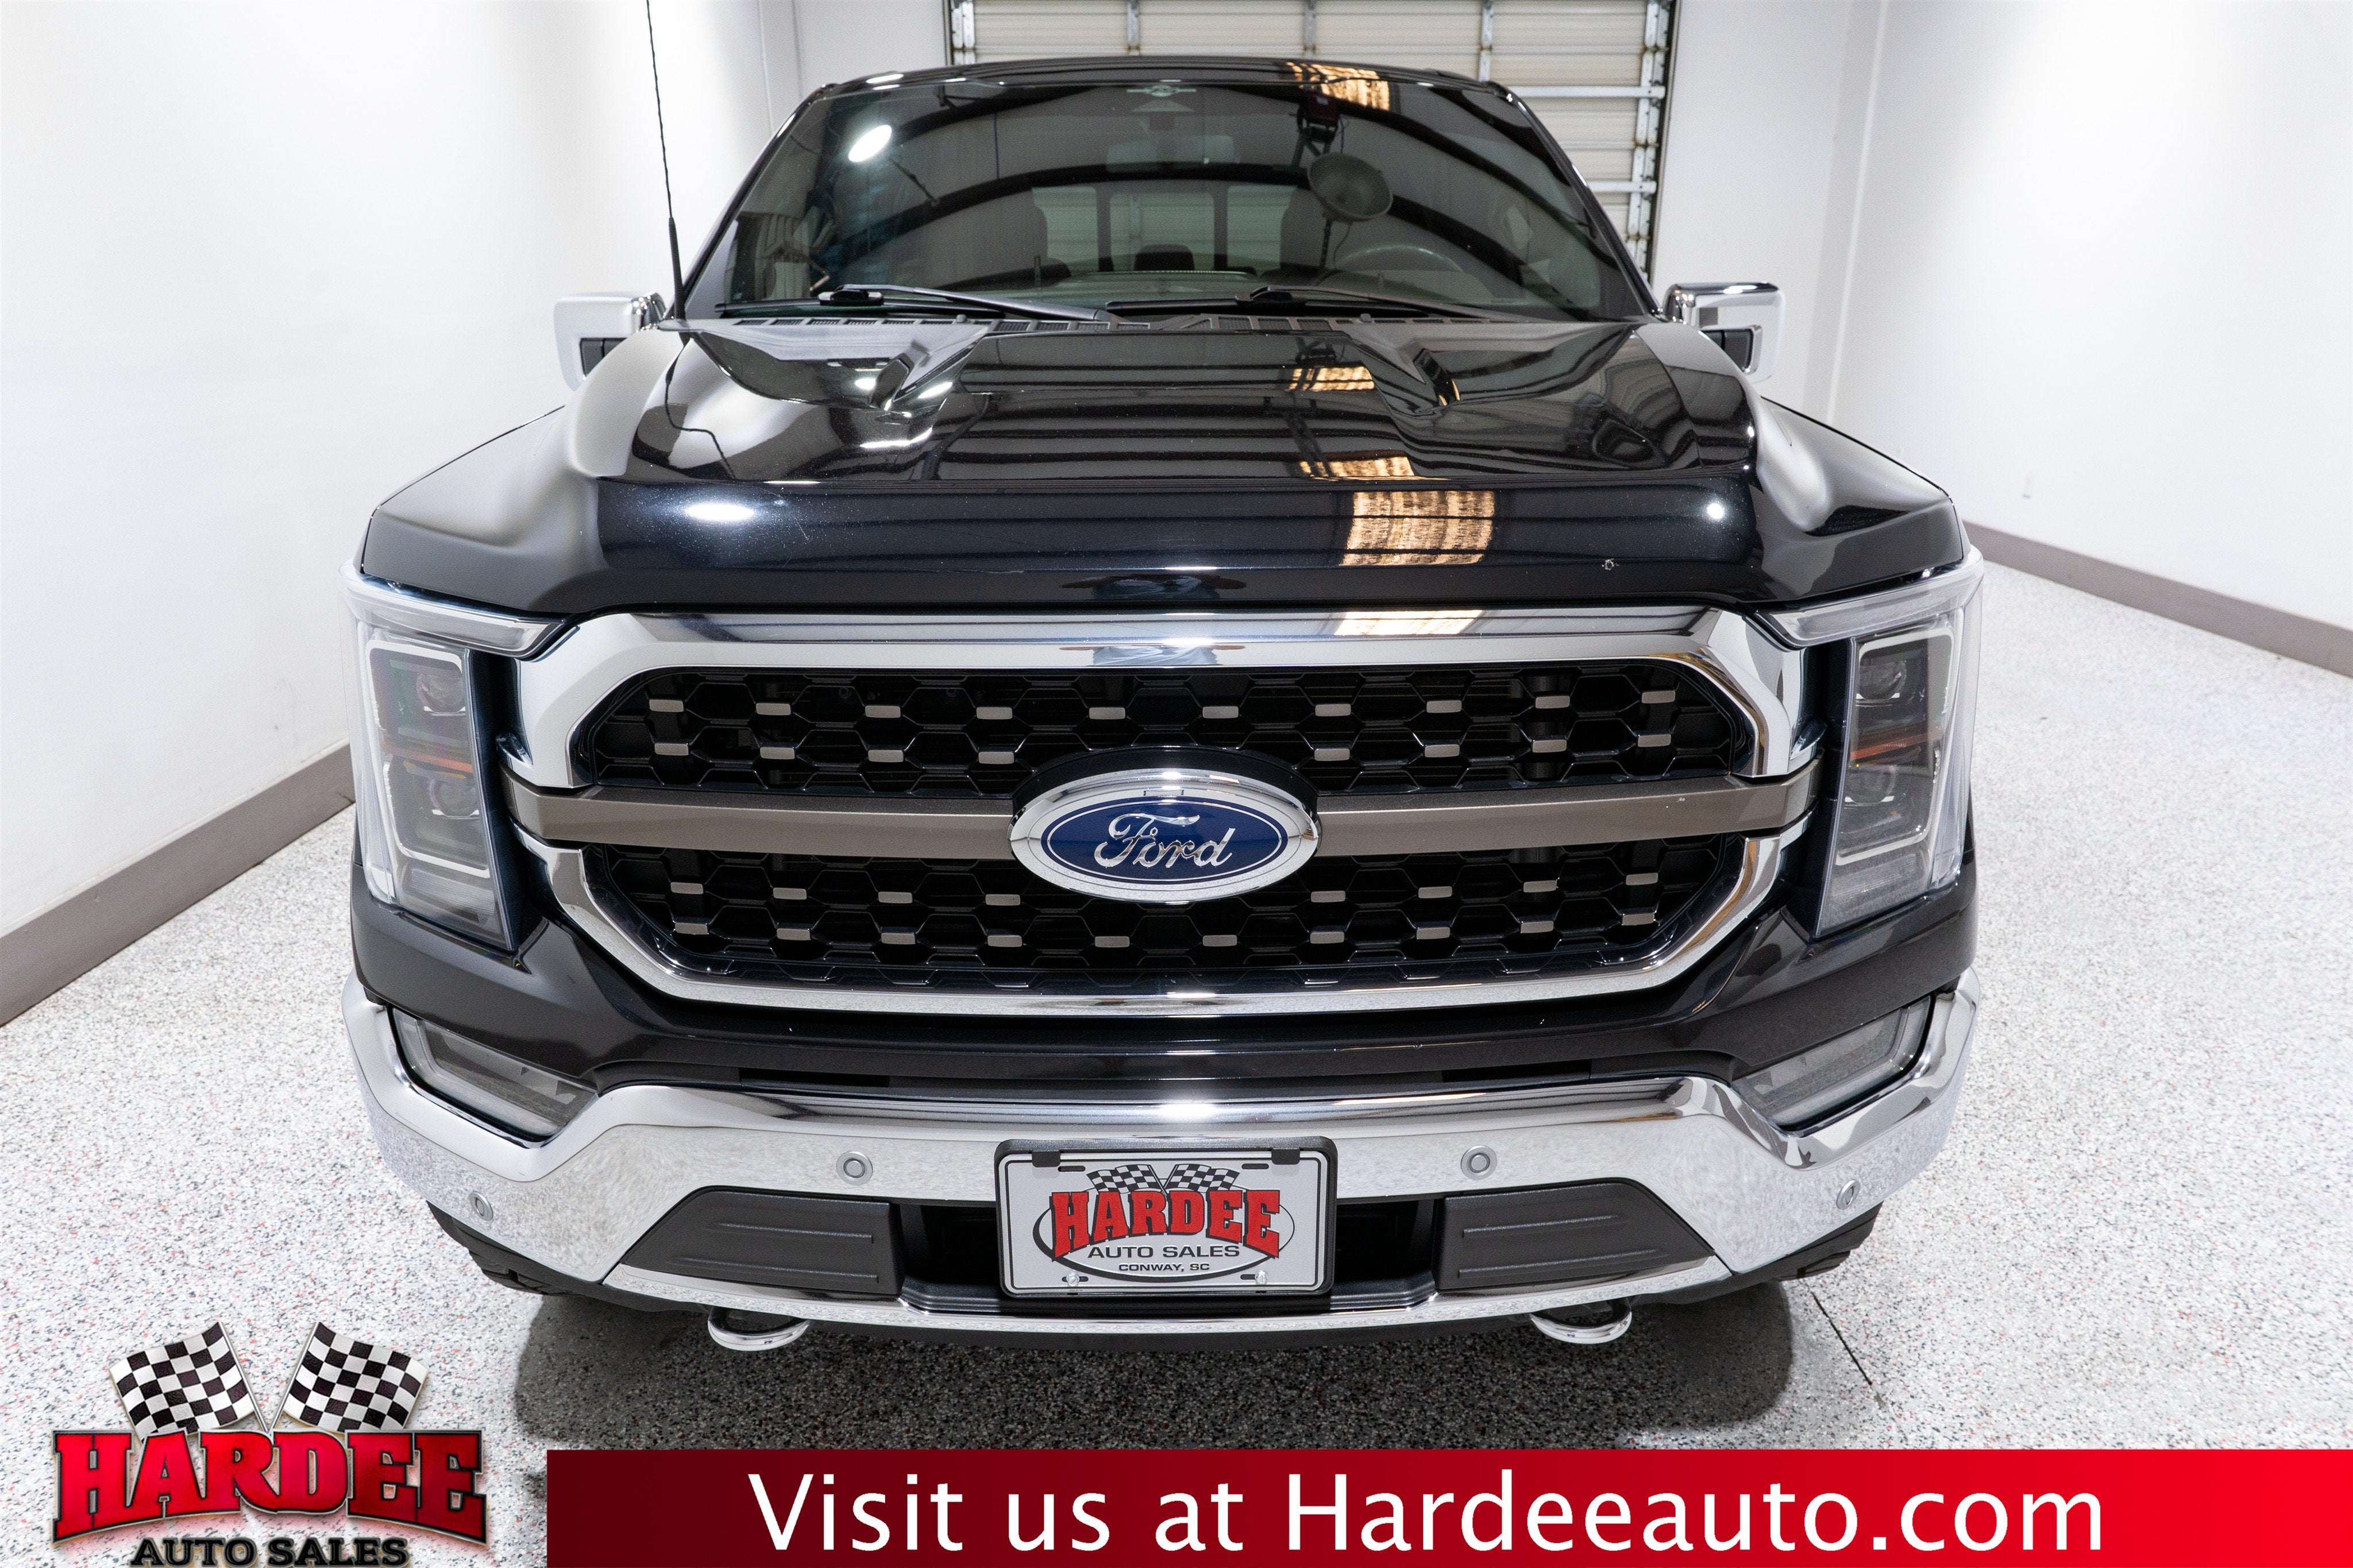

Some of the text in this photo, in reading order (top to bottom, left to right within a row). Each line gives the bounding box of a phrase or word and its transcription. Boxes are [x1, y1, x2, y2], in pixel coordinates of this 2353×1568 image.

[1094, 813, 1235, 868] Ford
[1050, 1190, 1280, 1260] HARDEE
[1087, 1246, 1240, 1258] AUTO SALES
[1118, 1264, 1185, 1273] CONWAY,
